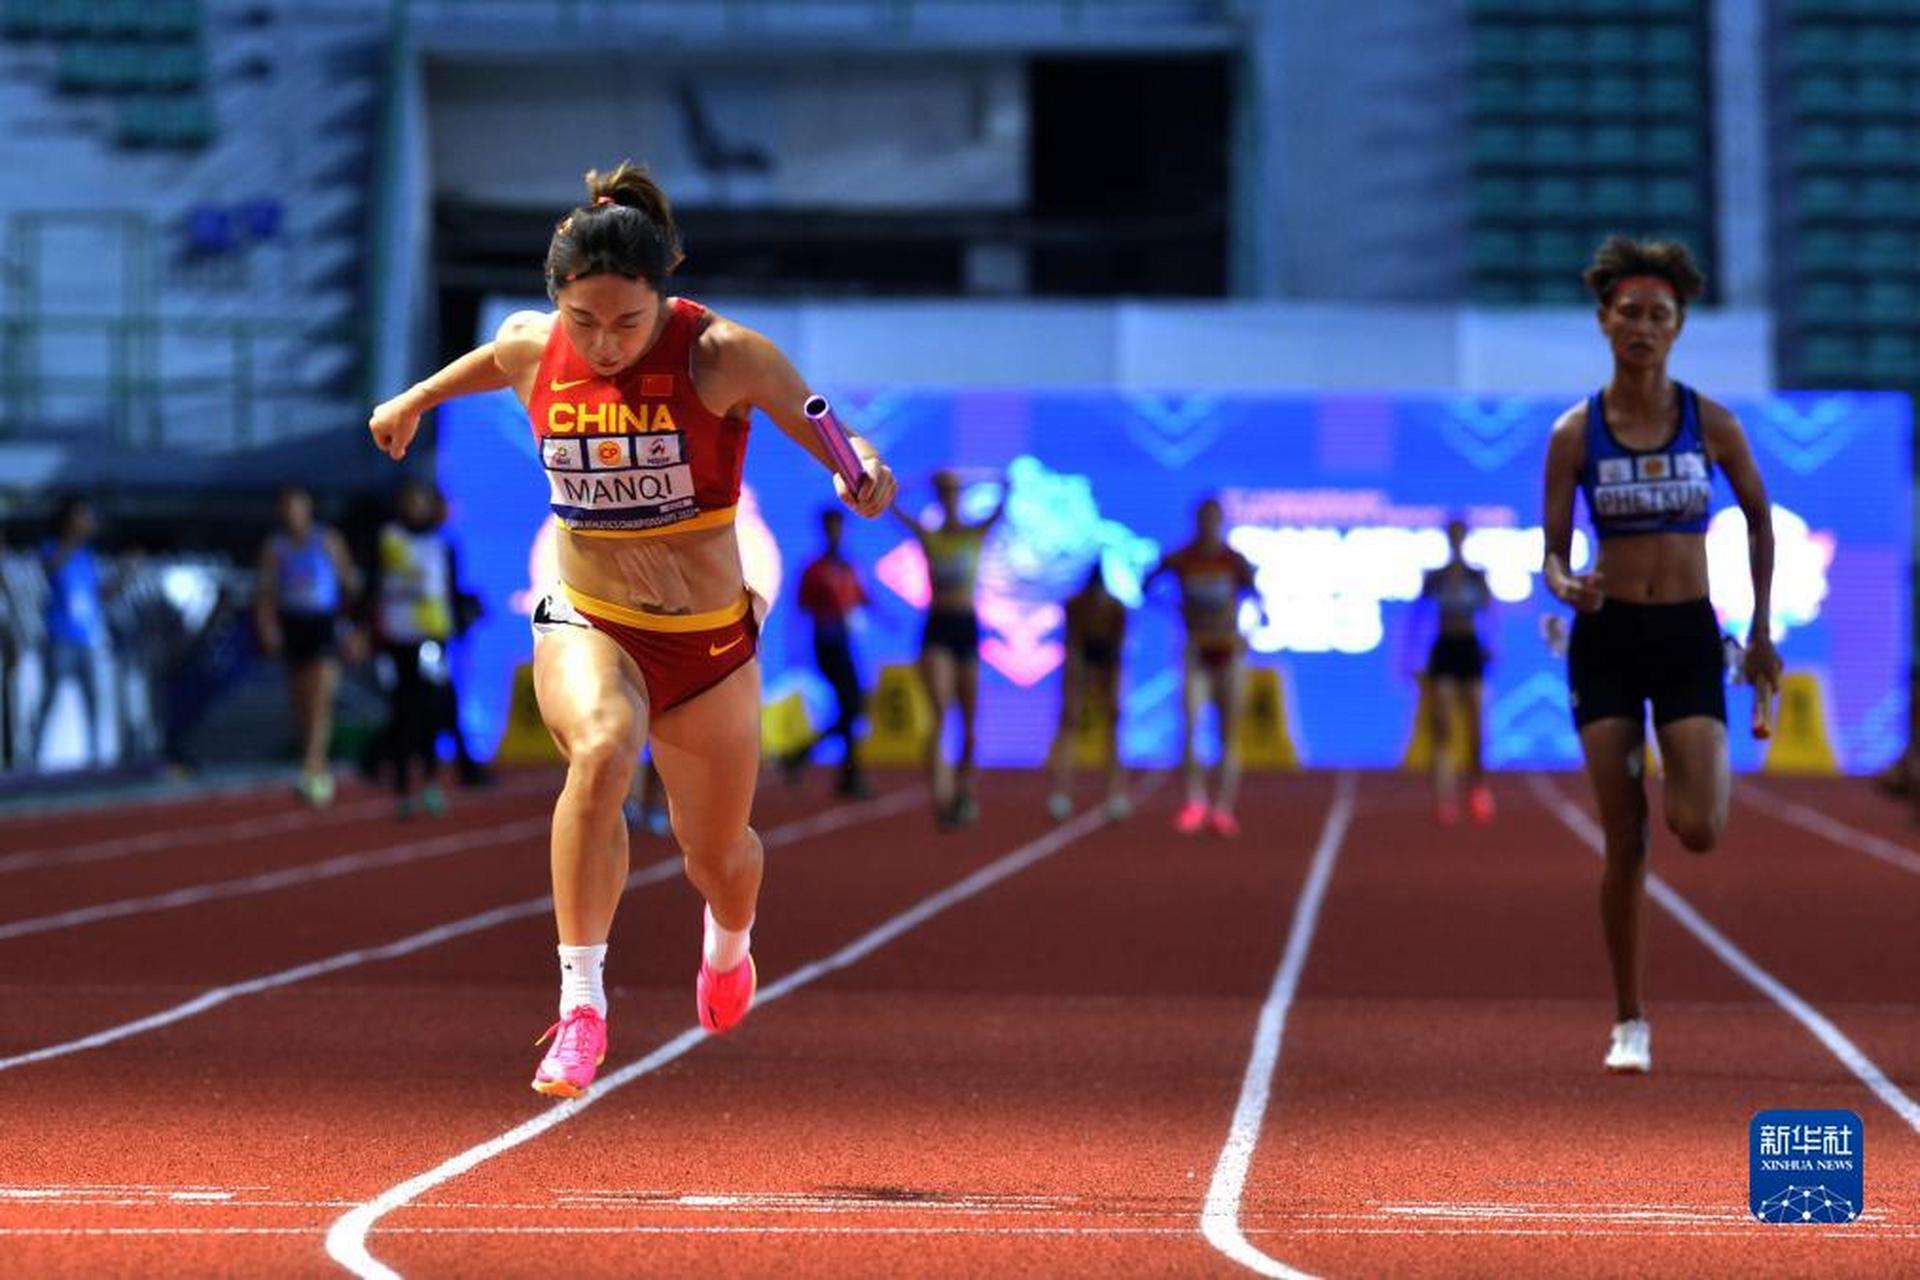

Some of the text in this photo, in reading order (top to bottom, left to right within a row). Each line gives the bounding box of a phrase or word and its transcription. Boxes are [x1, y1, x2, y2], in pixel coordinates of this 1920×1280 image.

[548, 402, 677, 433] CHINA
[599, 448, 617, 459] CP
[563, 474, 672, 503] MANQI
